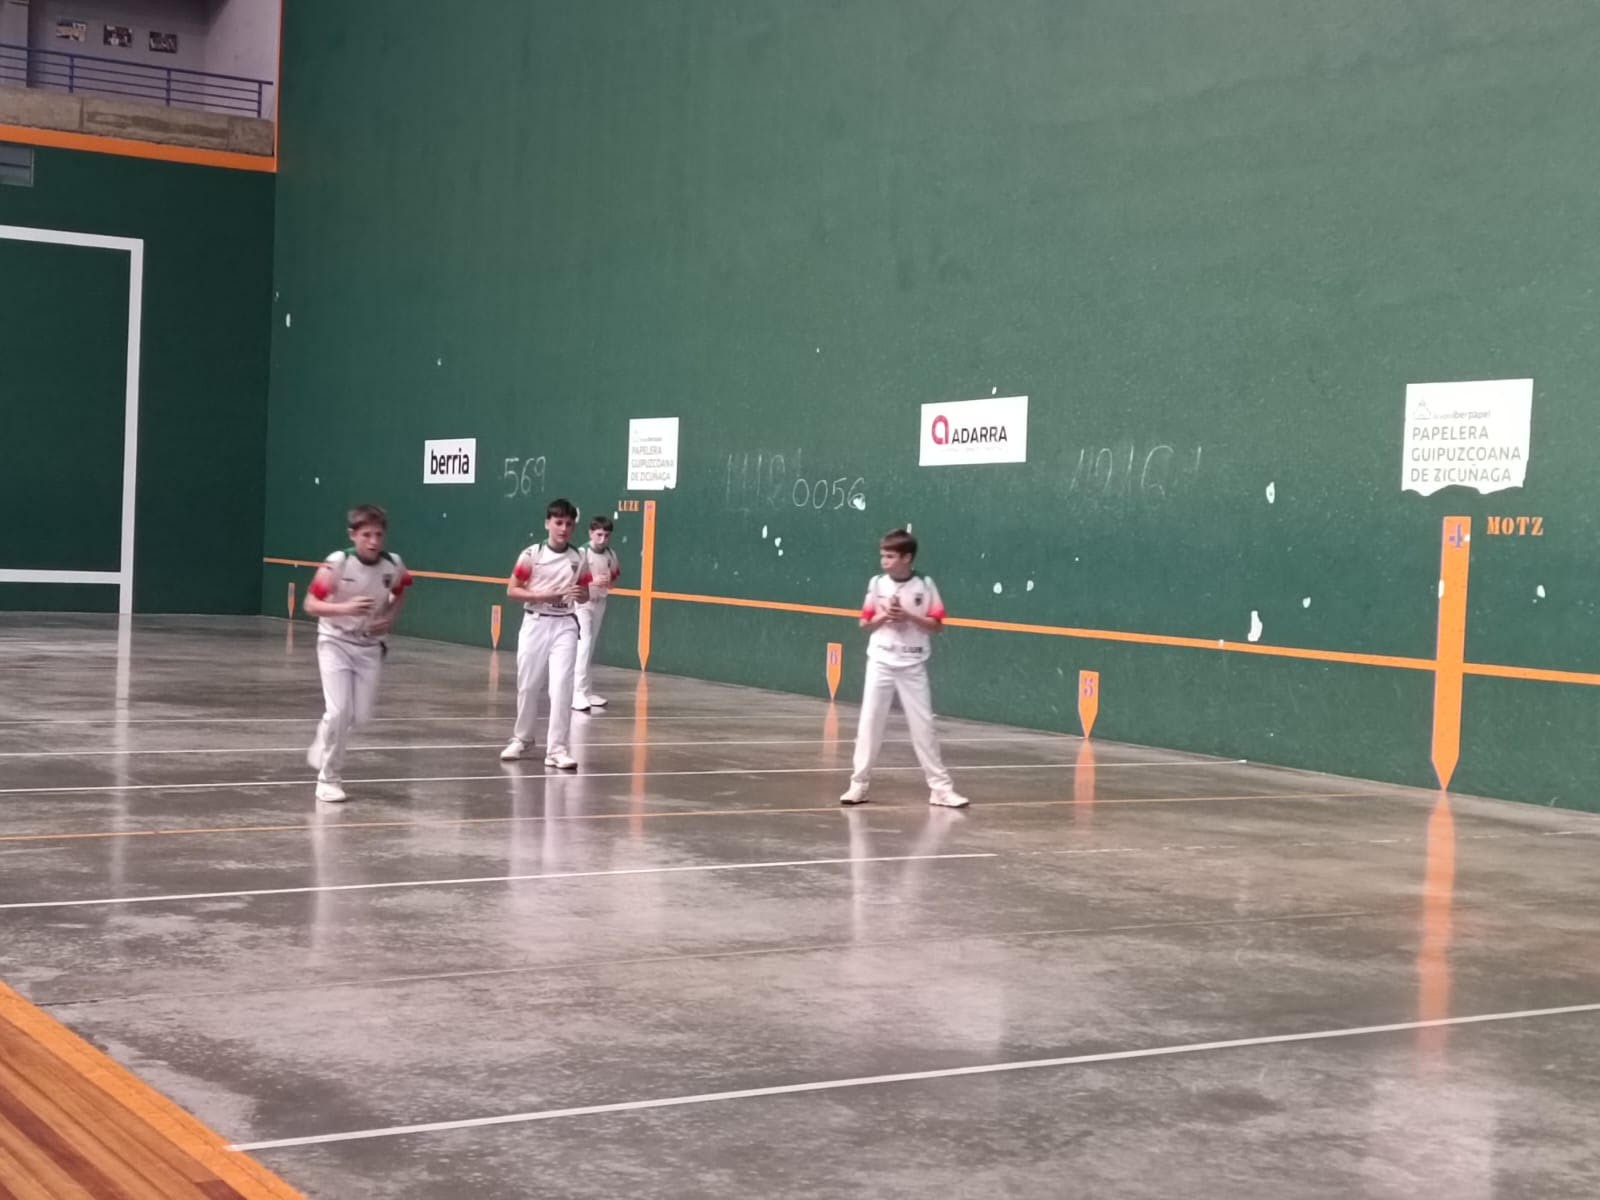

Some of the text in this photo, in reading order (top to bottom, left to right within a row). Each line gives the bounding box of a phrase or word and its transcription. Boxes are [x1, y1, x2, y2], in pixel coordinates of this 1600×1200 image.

[951, 425, 1008, 444] ADARRA
[1412, 425, 1489, 441] PAPELERA
[430, 448, 470, 475] berria
[1411, 446, 1522, 462] GUIPUZCOANA
[503, 455, 546, 498] 569
[1410, 463, 1512, 483] DE ZICUÑAGA
[792, 476, 866, 511] 0056
[1486, 516, 1544, 536] MOTZ
